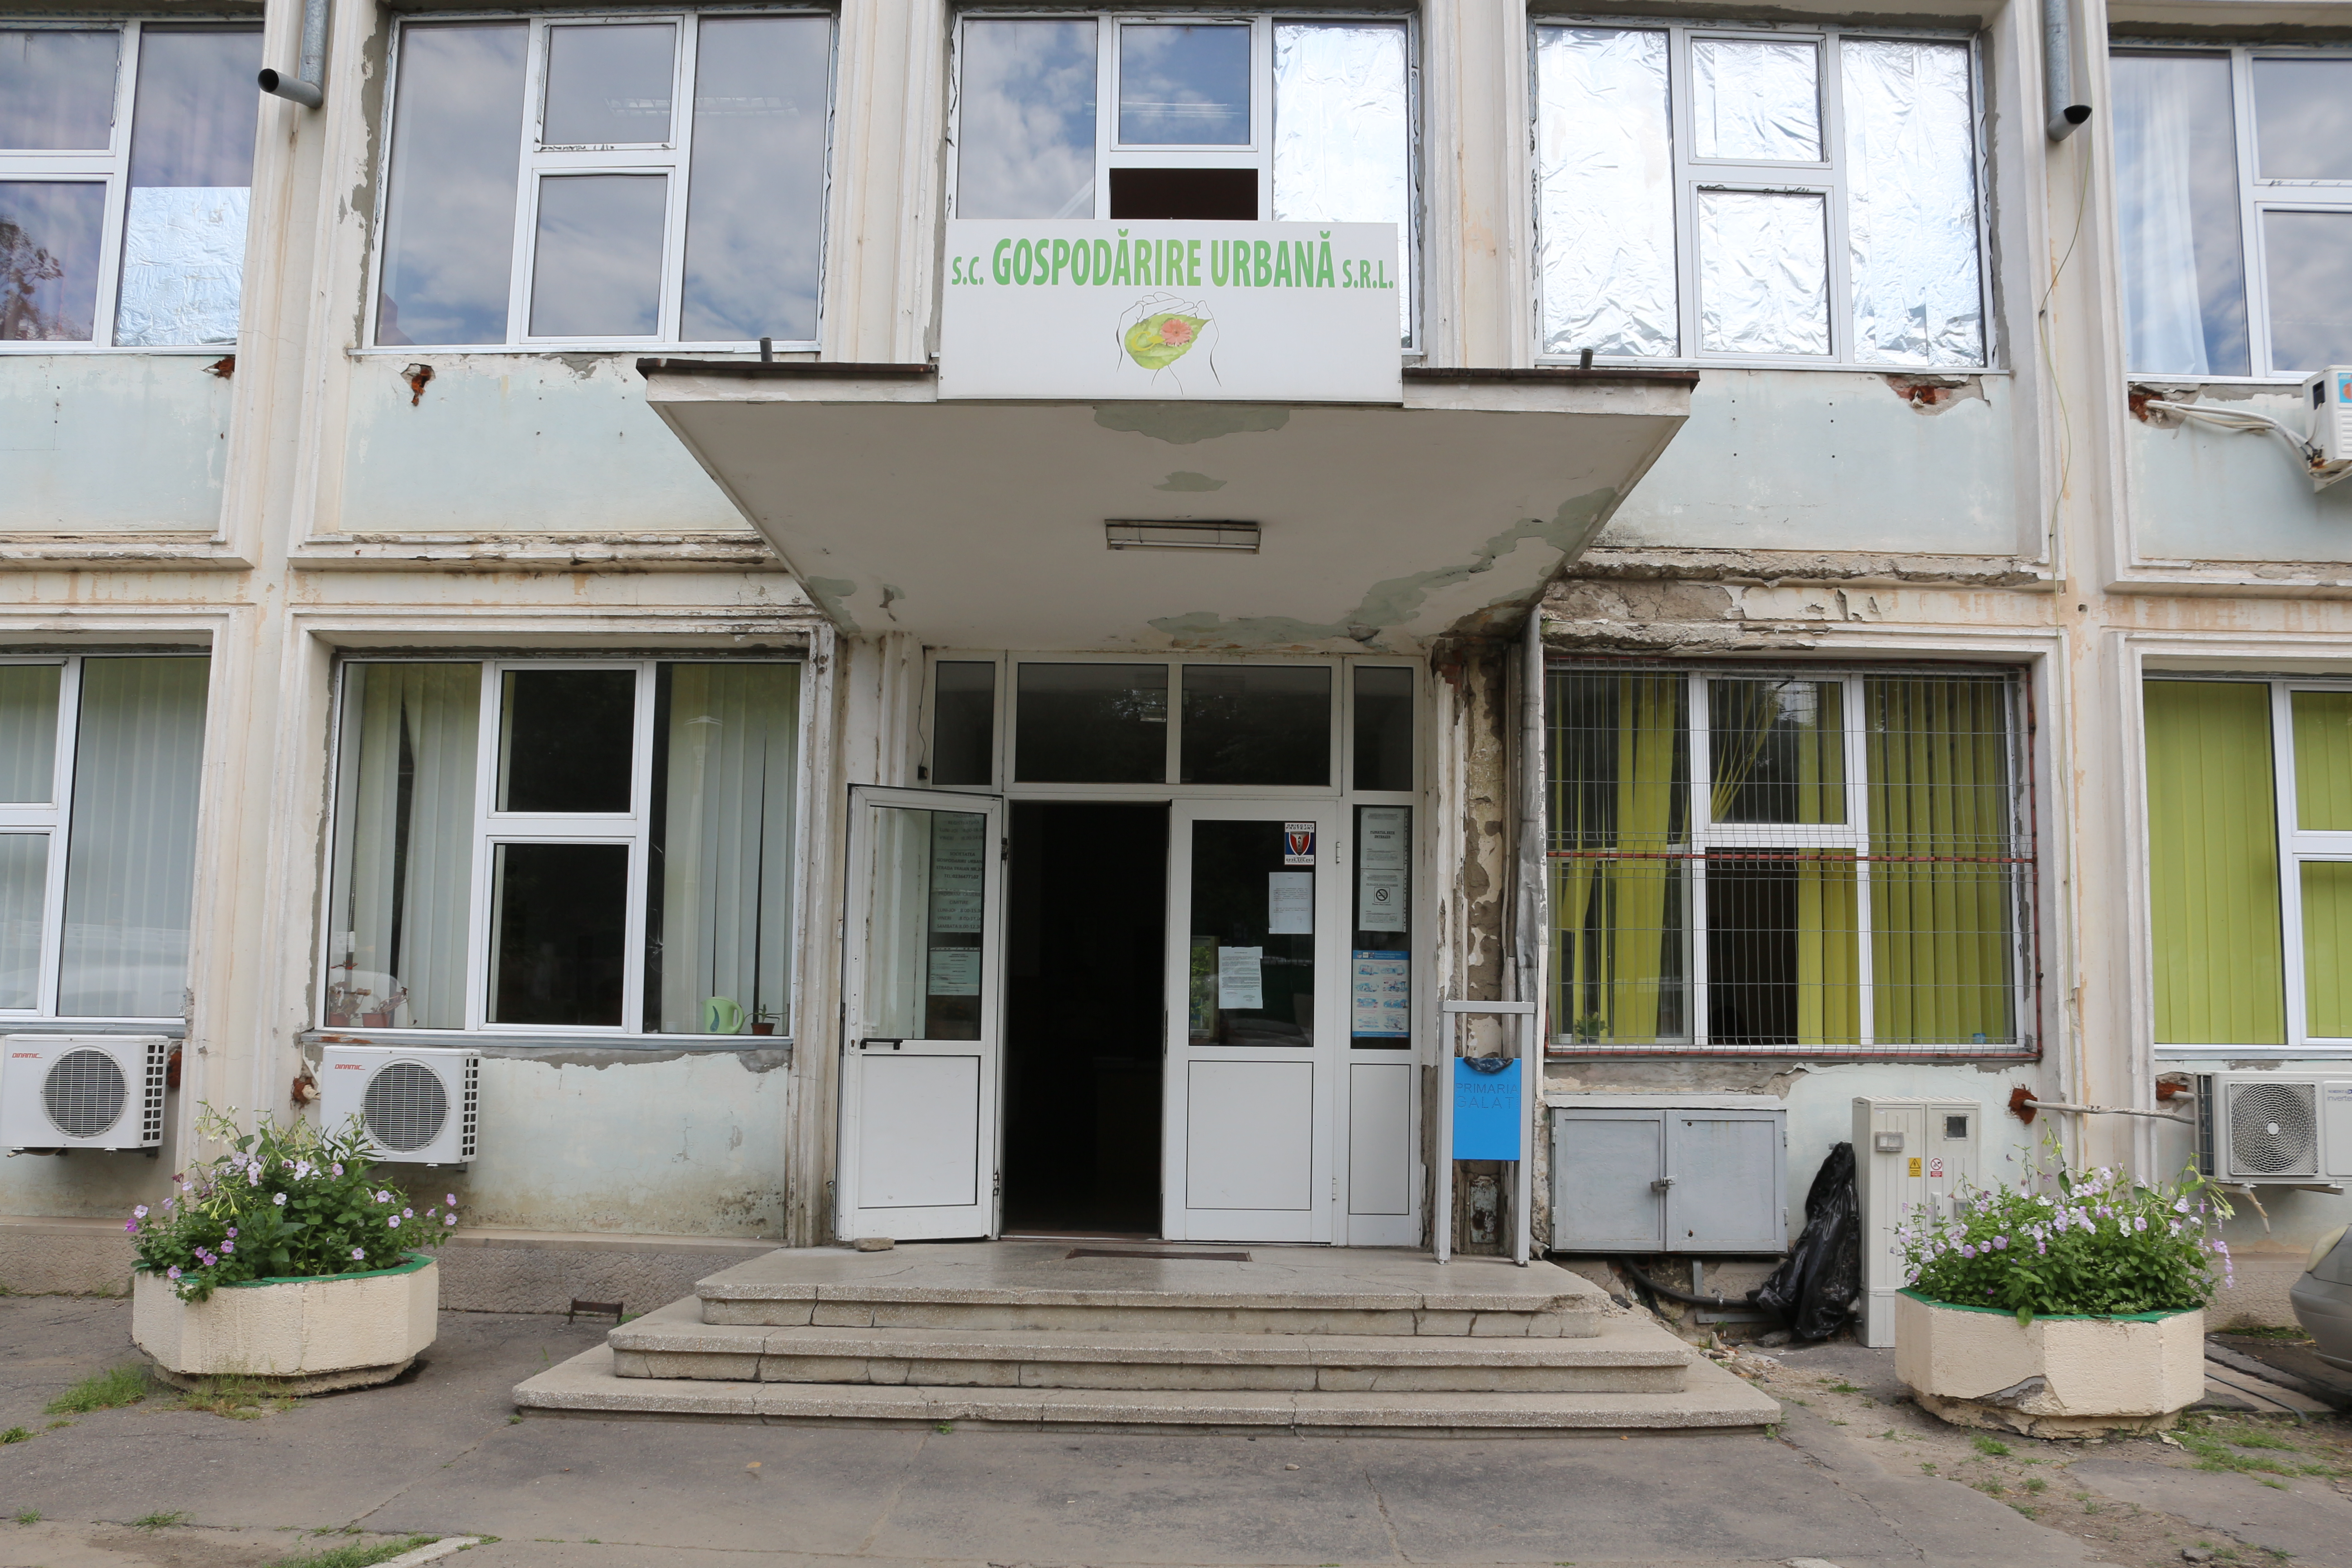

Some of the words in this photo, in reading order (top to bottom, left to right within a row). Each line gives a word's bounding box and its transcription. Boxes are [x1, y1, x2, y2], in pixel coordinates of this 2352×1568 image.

[951, 256, 984, 285] S.C.
[992, 228, 1201, 286] GOSPODĂRIRE
[1210, 230, 1336, 288] URBANĂ
[1342, 259, 1394, 289] S.R.L.
[1455, 1083, 1519, 1094] PRIMARIA
[1455, 1096, 1519, 1109] GALATI
